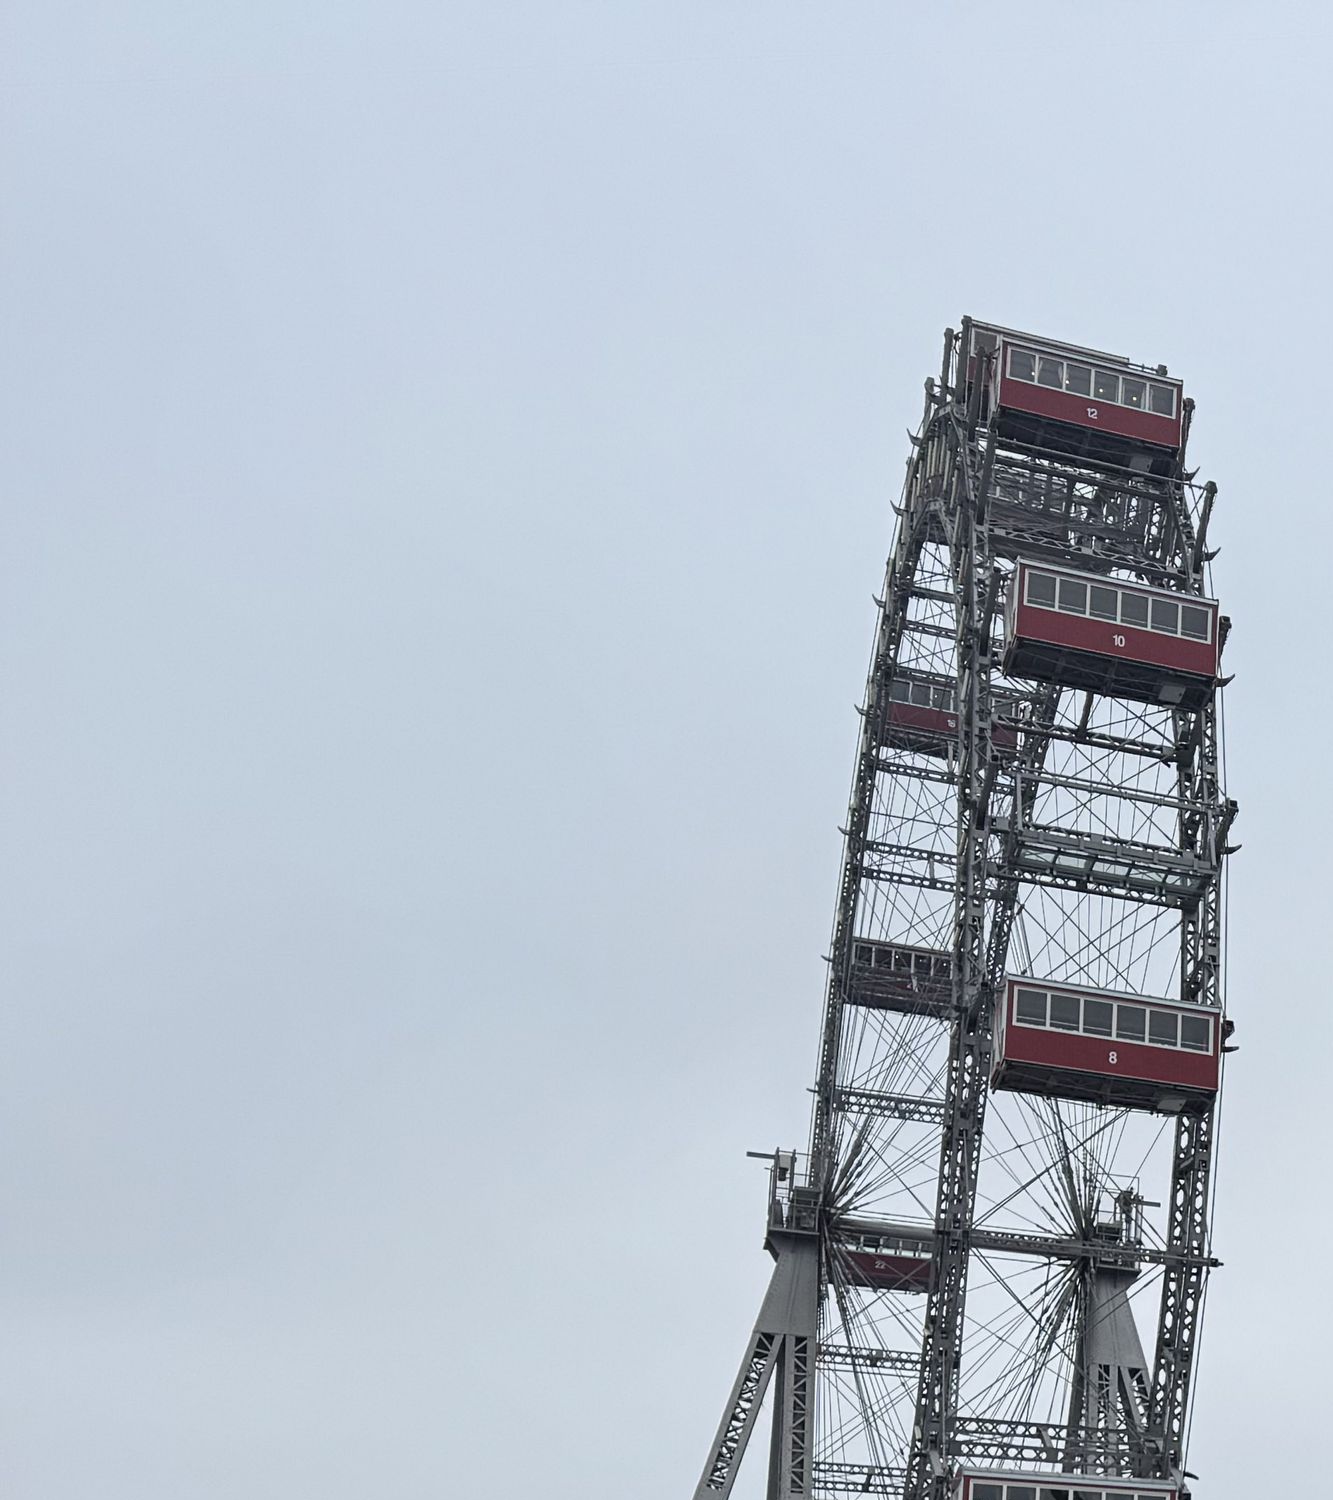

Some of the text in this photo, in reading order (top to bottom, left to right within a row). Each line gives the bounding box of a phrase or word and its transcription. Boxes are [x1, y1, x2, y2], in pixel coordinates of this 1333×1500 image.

[1086, 407, 1098, 420] 12
[1112, 634, 1126, 647] 10
[1108, 1051, 1118, 1064] 8
